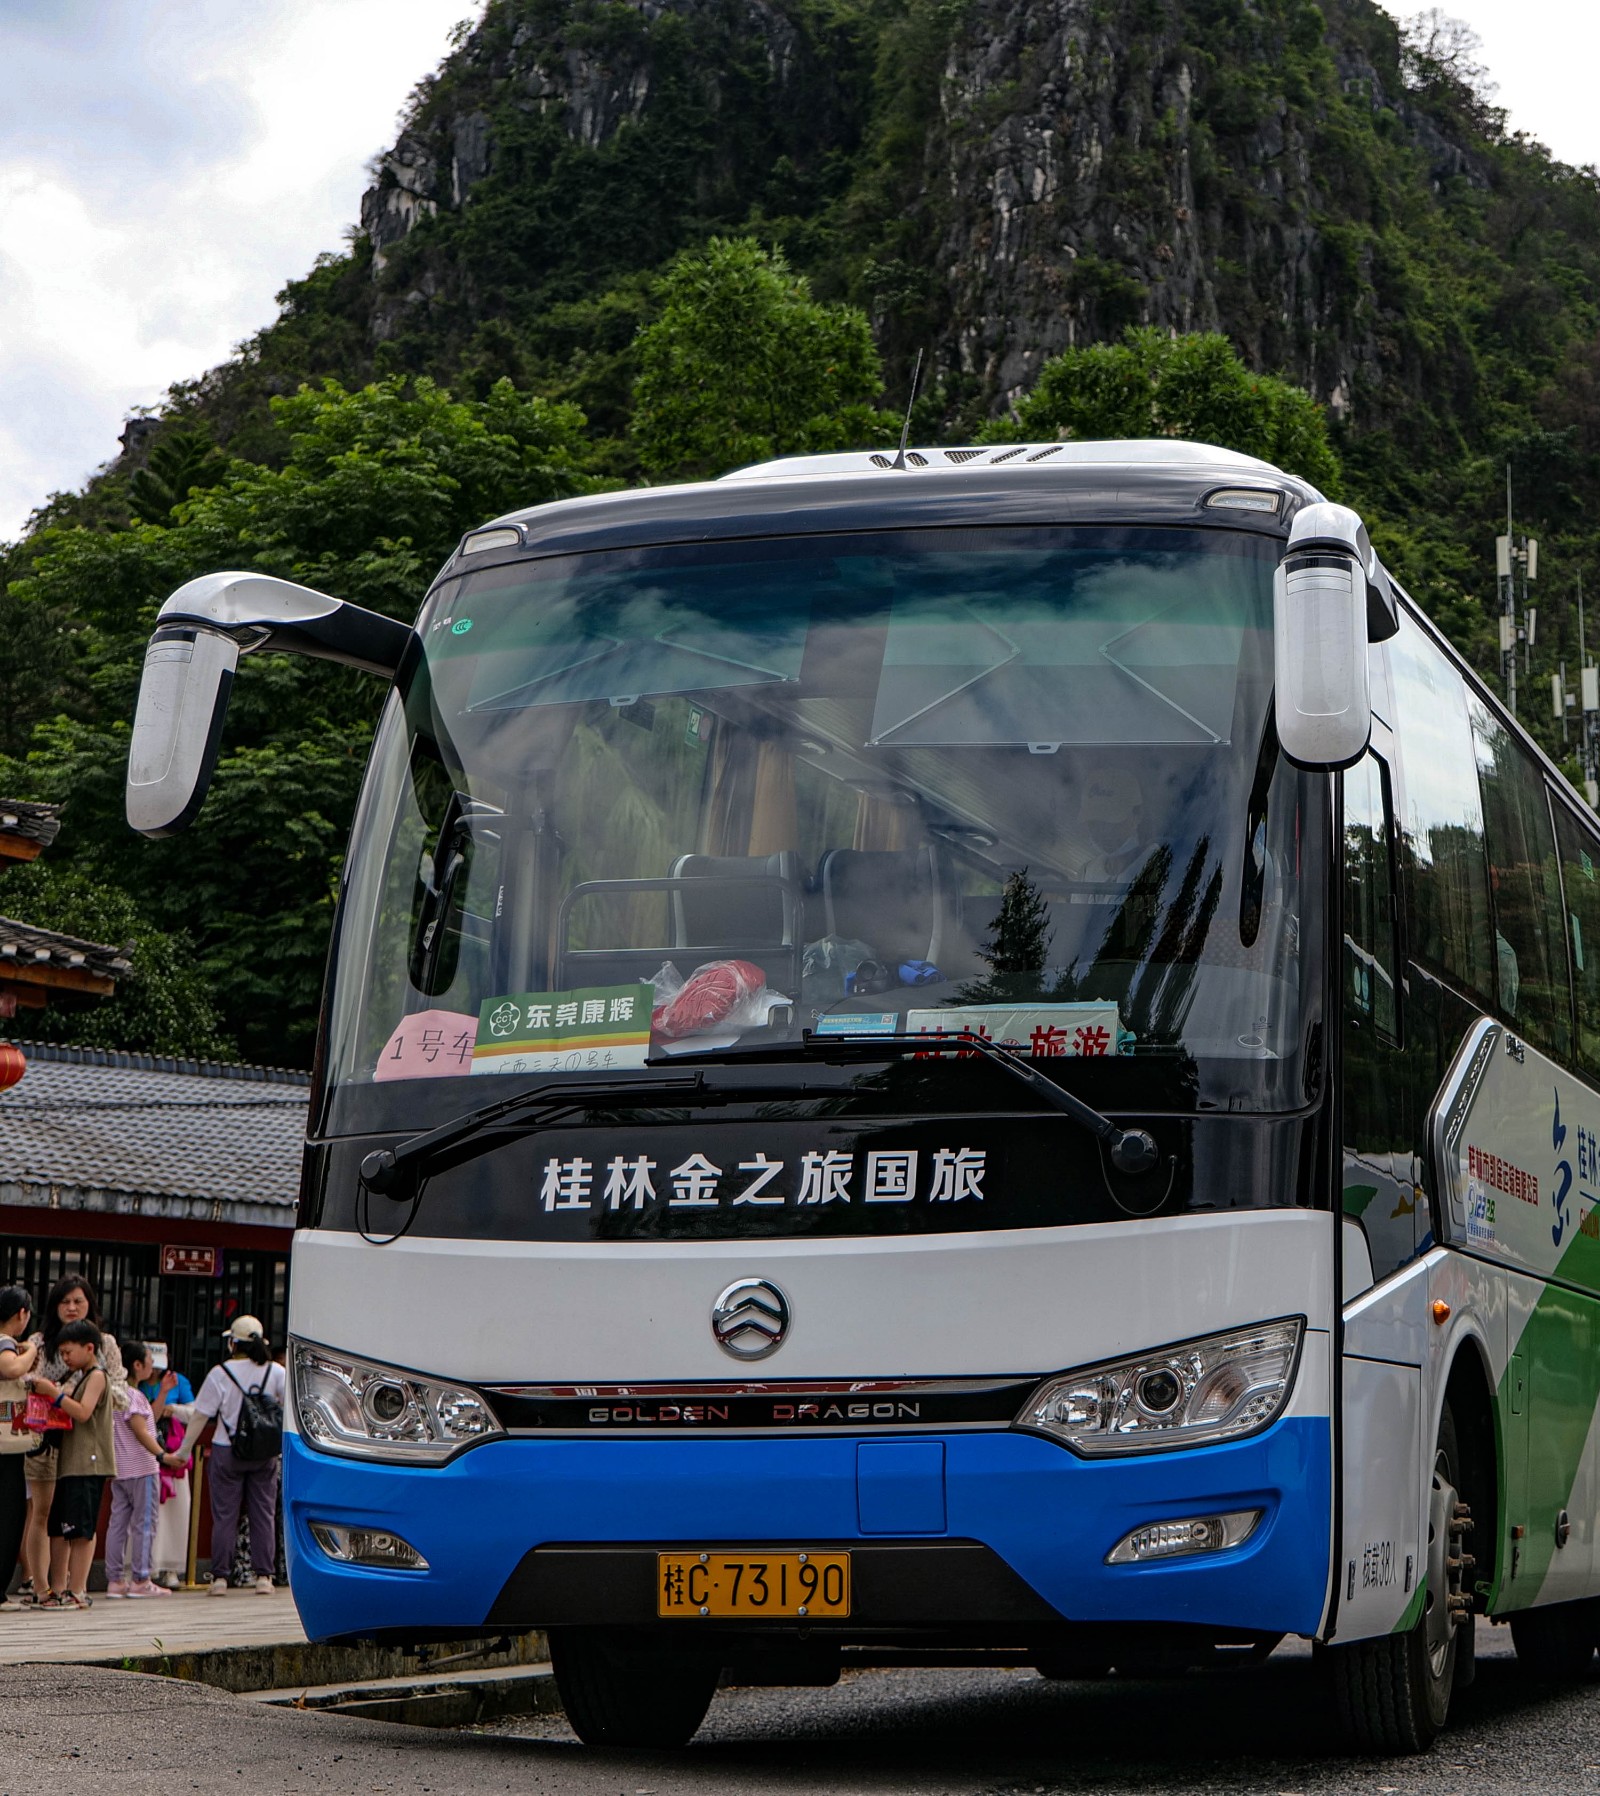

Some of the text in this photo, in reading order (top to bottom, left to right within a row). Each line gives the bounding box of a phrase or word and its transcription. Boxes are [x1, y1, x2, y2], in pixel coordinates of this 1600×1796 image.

[496, 1014, 514, 1024] CCT
[526, 997, 634, 1029] 东莞康辉
[541, 1147, 987, 1212] 桂林金之旅国旅
[588, 1402, 920, 1422] GOLDEN DRAGON
[1362, 1541, 1397, 1588] 核载38人
[664, 1563, 844, 1606] 桂C·73190
